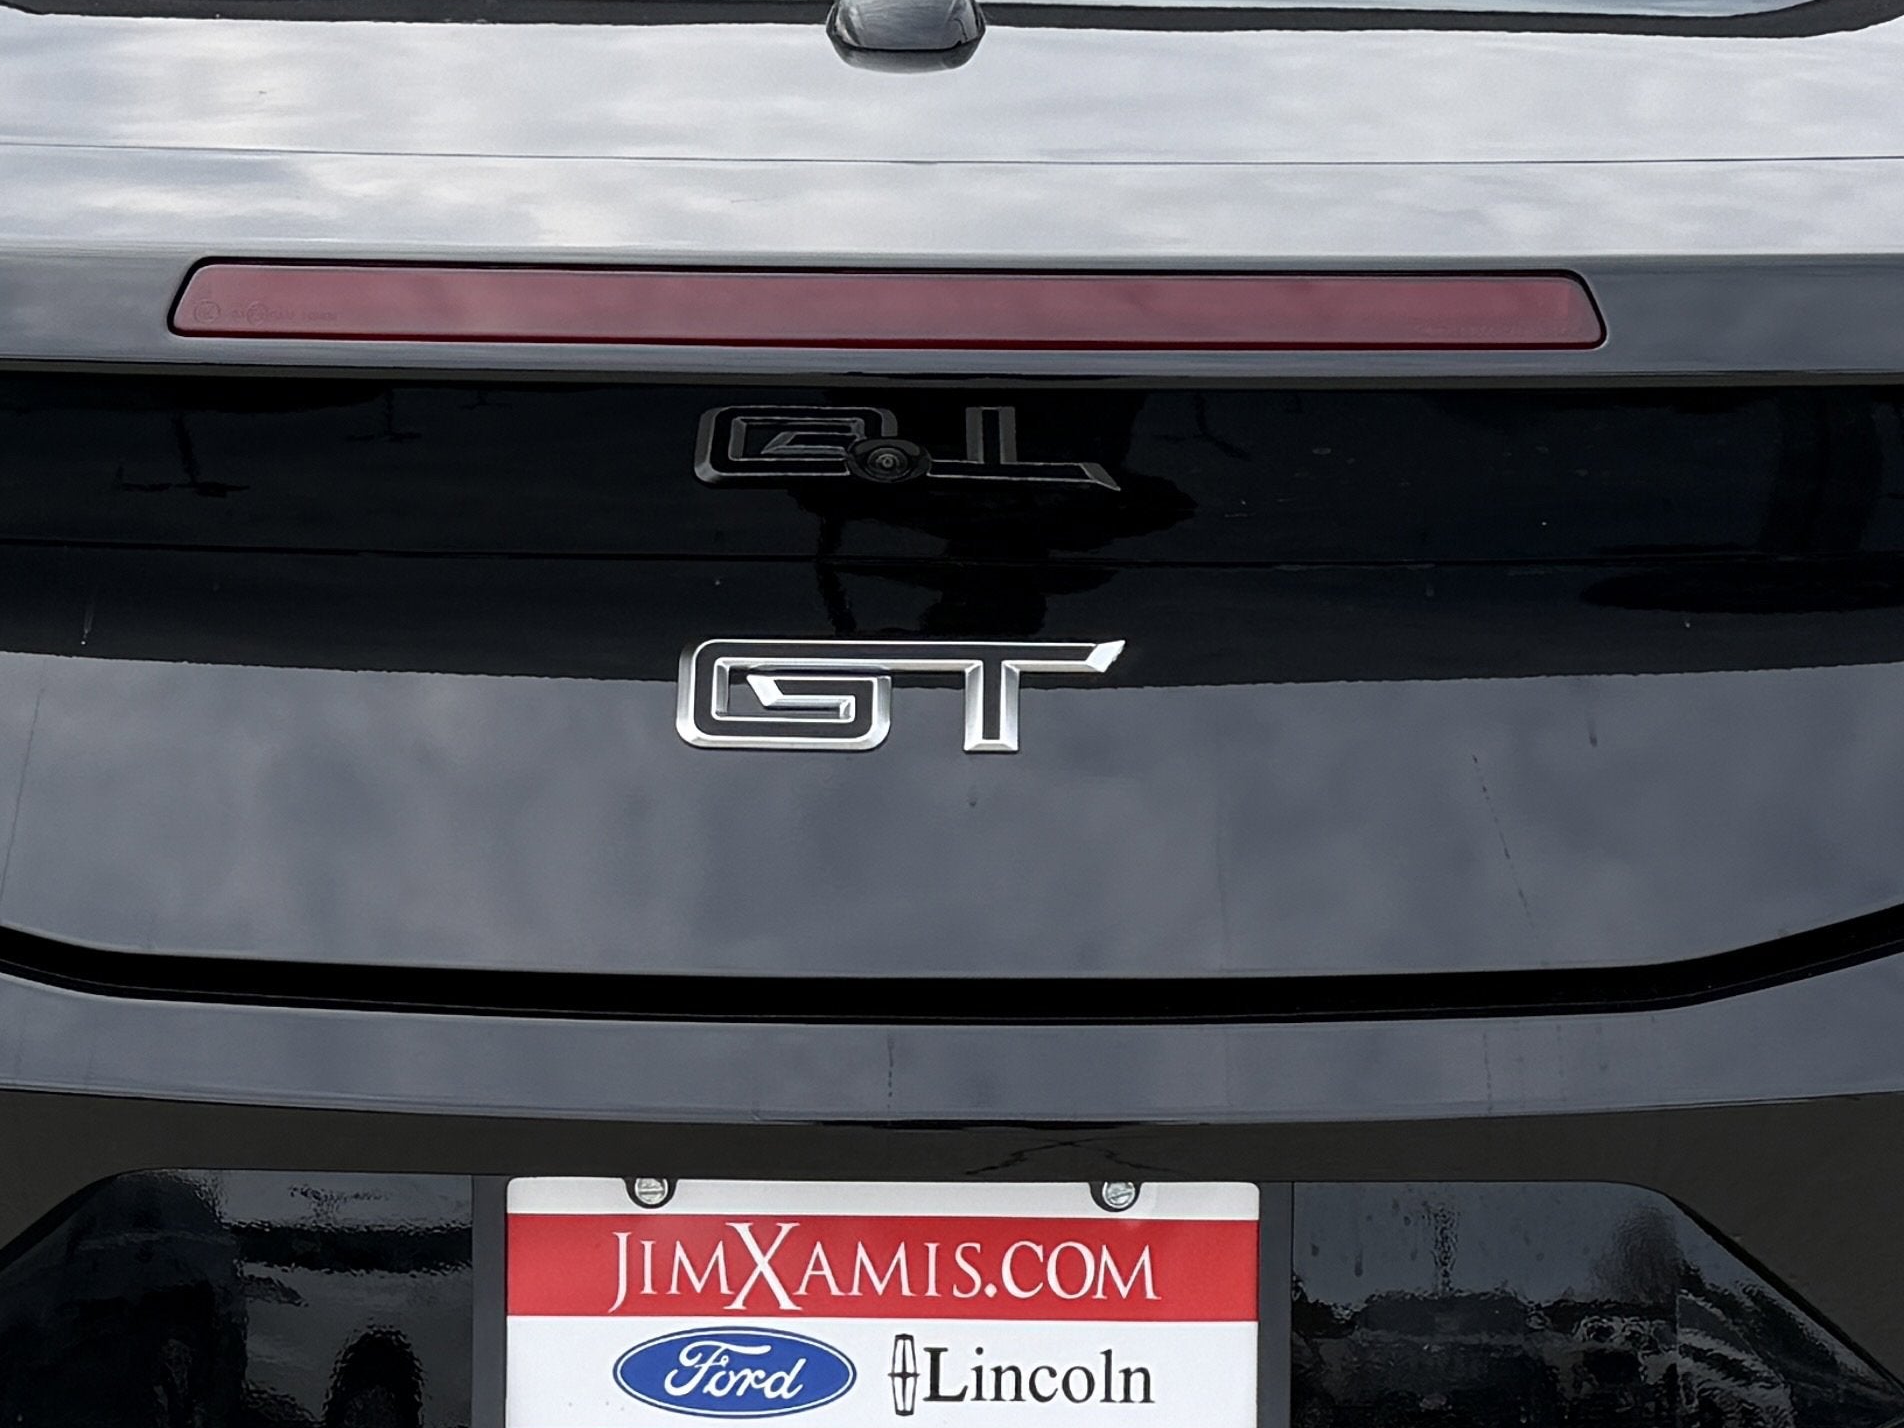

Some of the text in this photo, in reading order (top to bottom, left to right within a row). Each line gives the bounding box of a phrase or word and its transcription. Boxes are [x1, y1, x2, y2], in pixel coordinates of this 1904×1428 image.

[676, 638, 1127, 752] GT
[663, 1340, 807, 1400] Ford
[922, 1347, 1156, 1404] Lincoln
